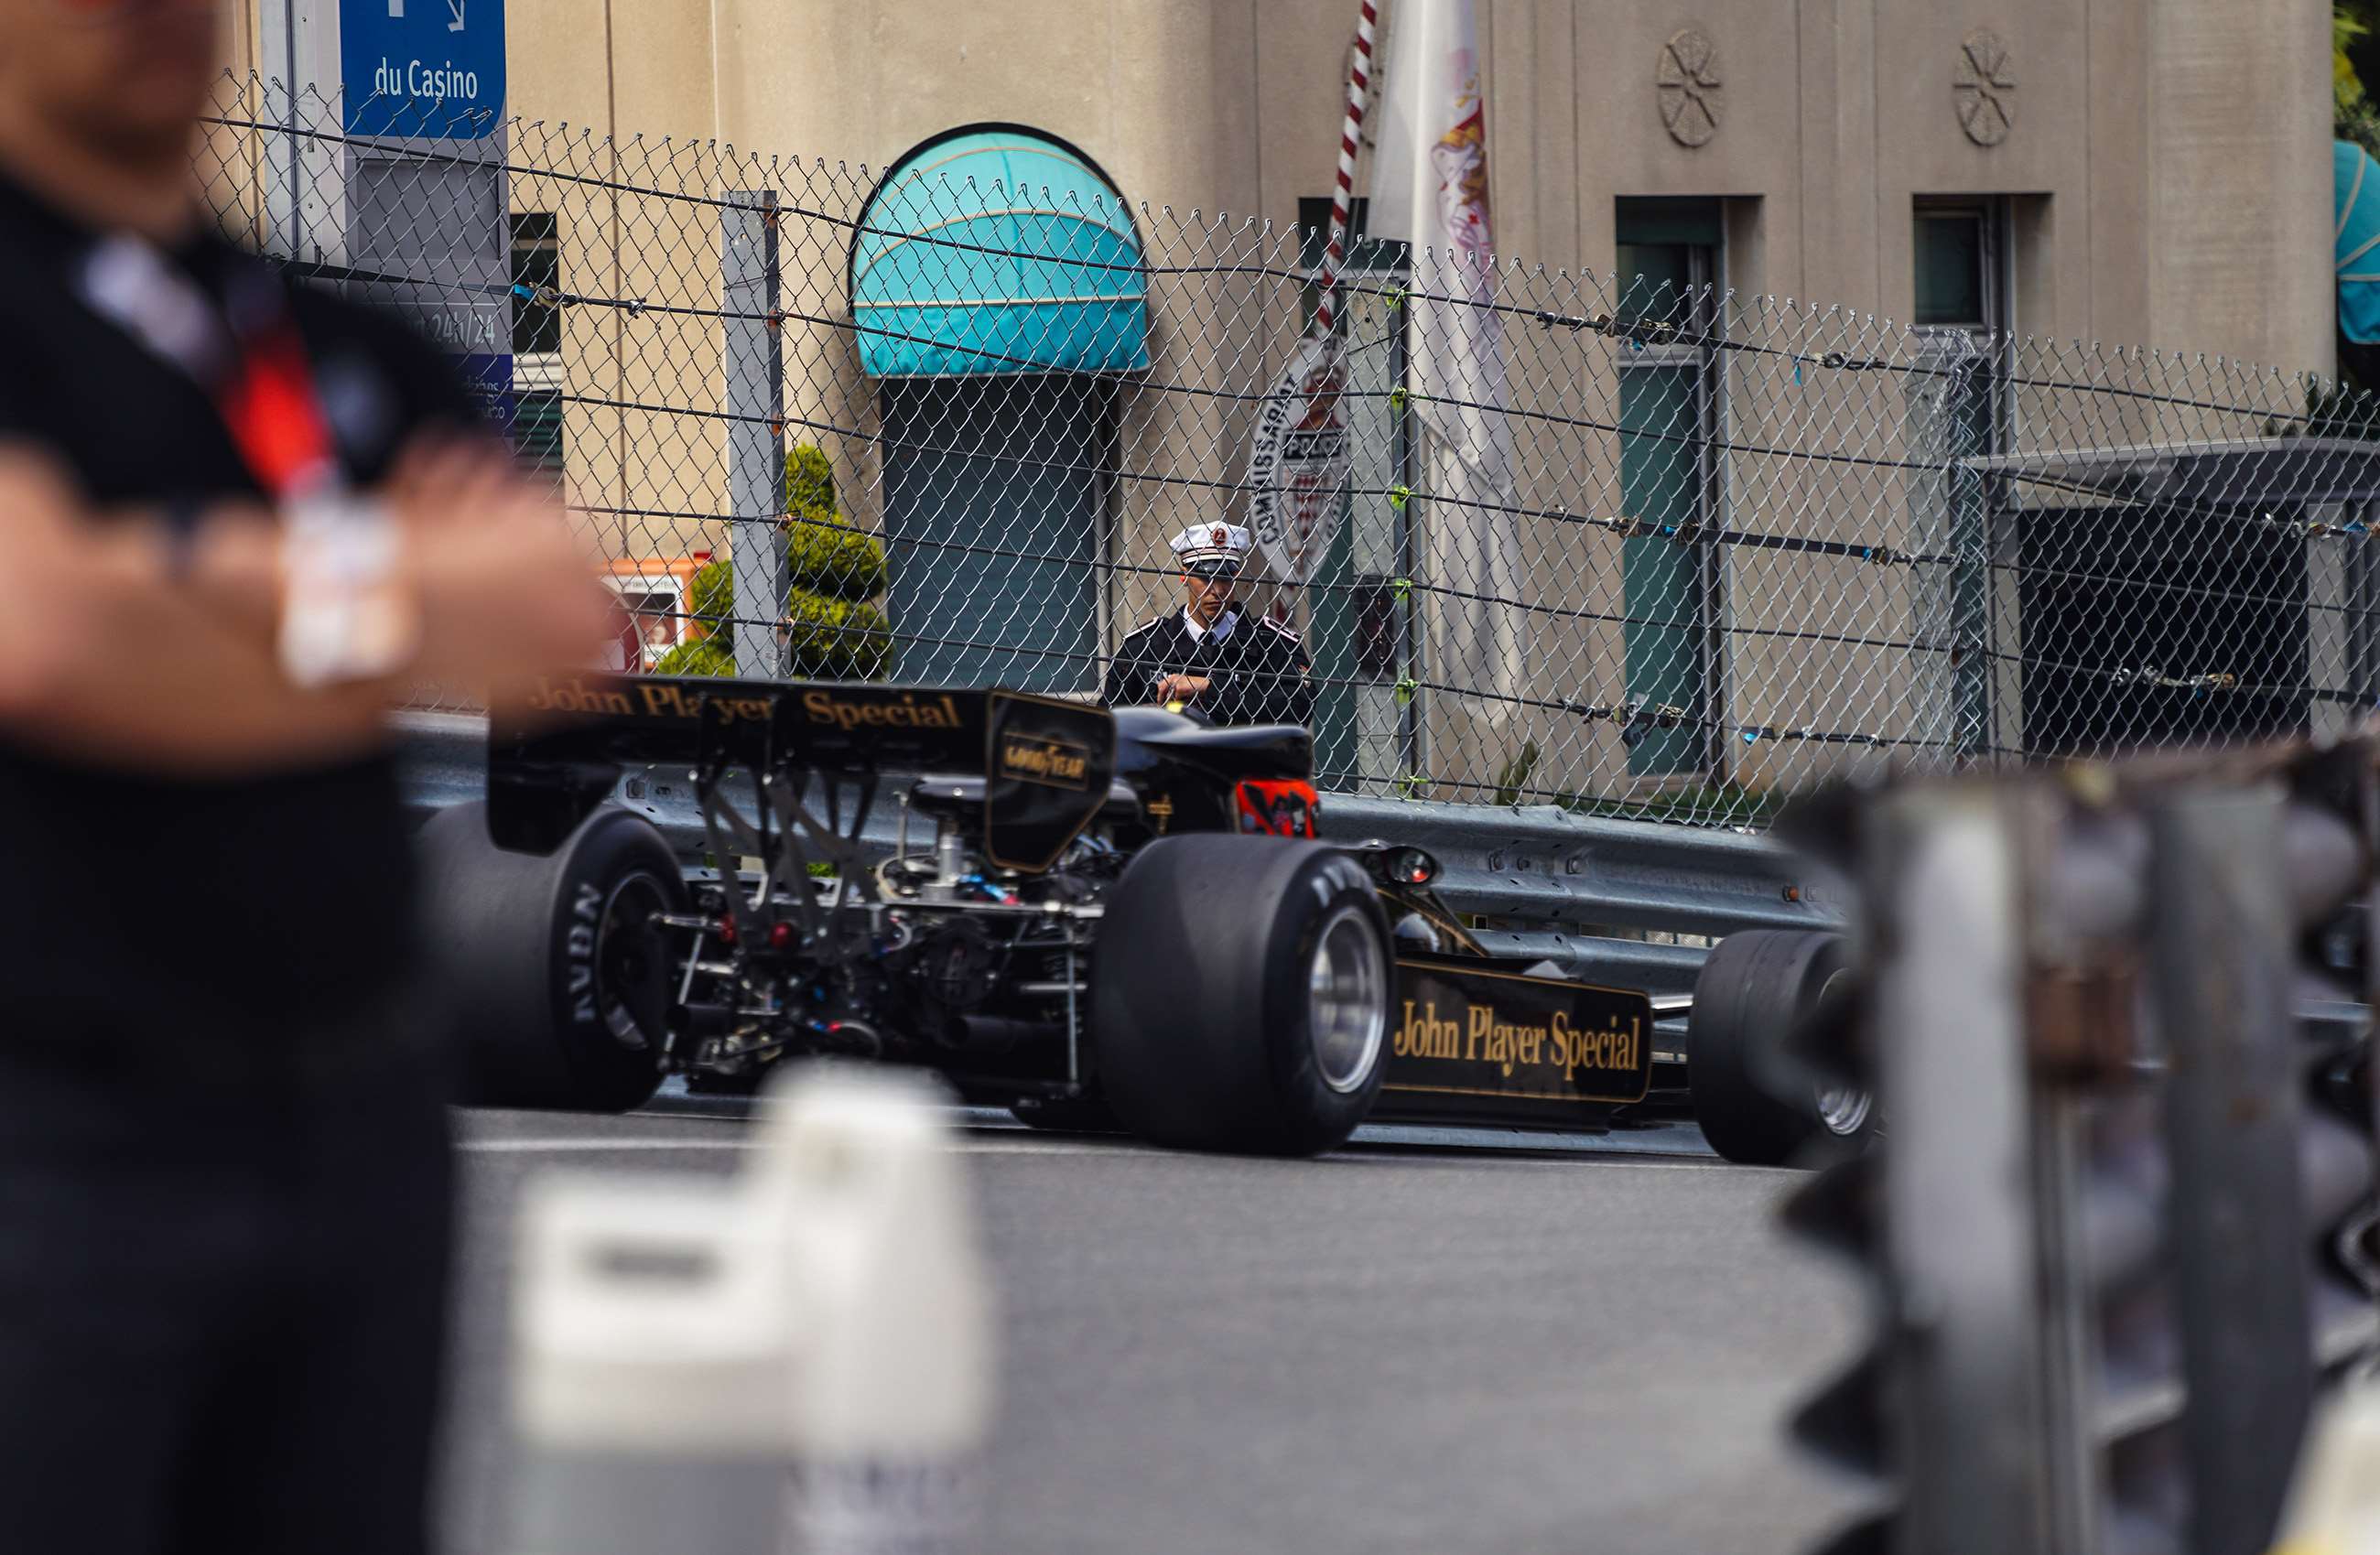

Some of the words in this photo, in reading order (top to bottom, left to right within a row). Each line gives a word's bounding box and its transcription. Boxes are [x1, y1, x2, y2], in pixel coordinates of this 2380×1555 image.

[375, 57, 402, 95] du
[408, 59, 477, 99] Casino
[528, 676, 636, 716] John
[803, 693, 962, 729] Special
[1394, 1001, 1460, 1059] John
[1465, 1005, 1546, 1077] Player
[1551, 1011, 1641, 1081] Special
